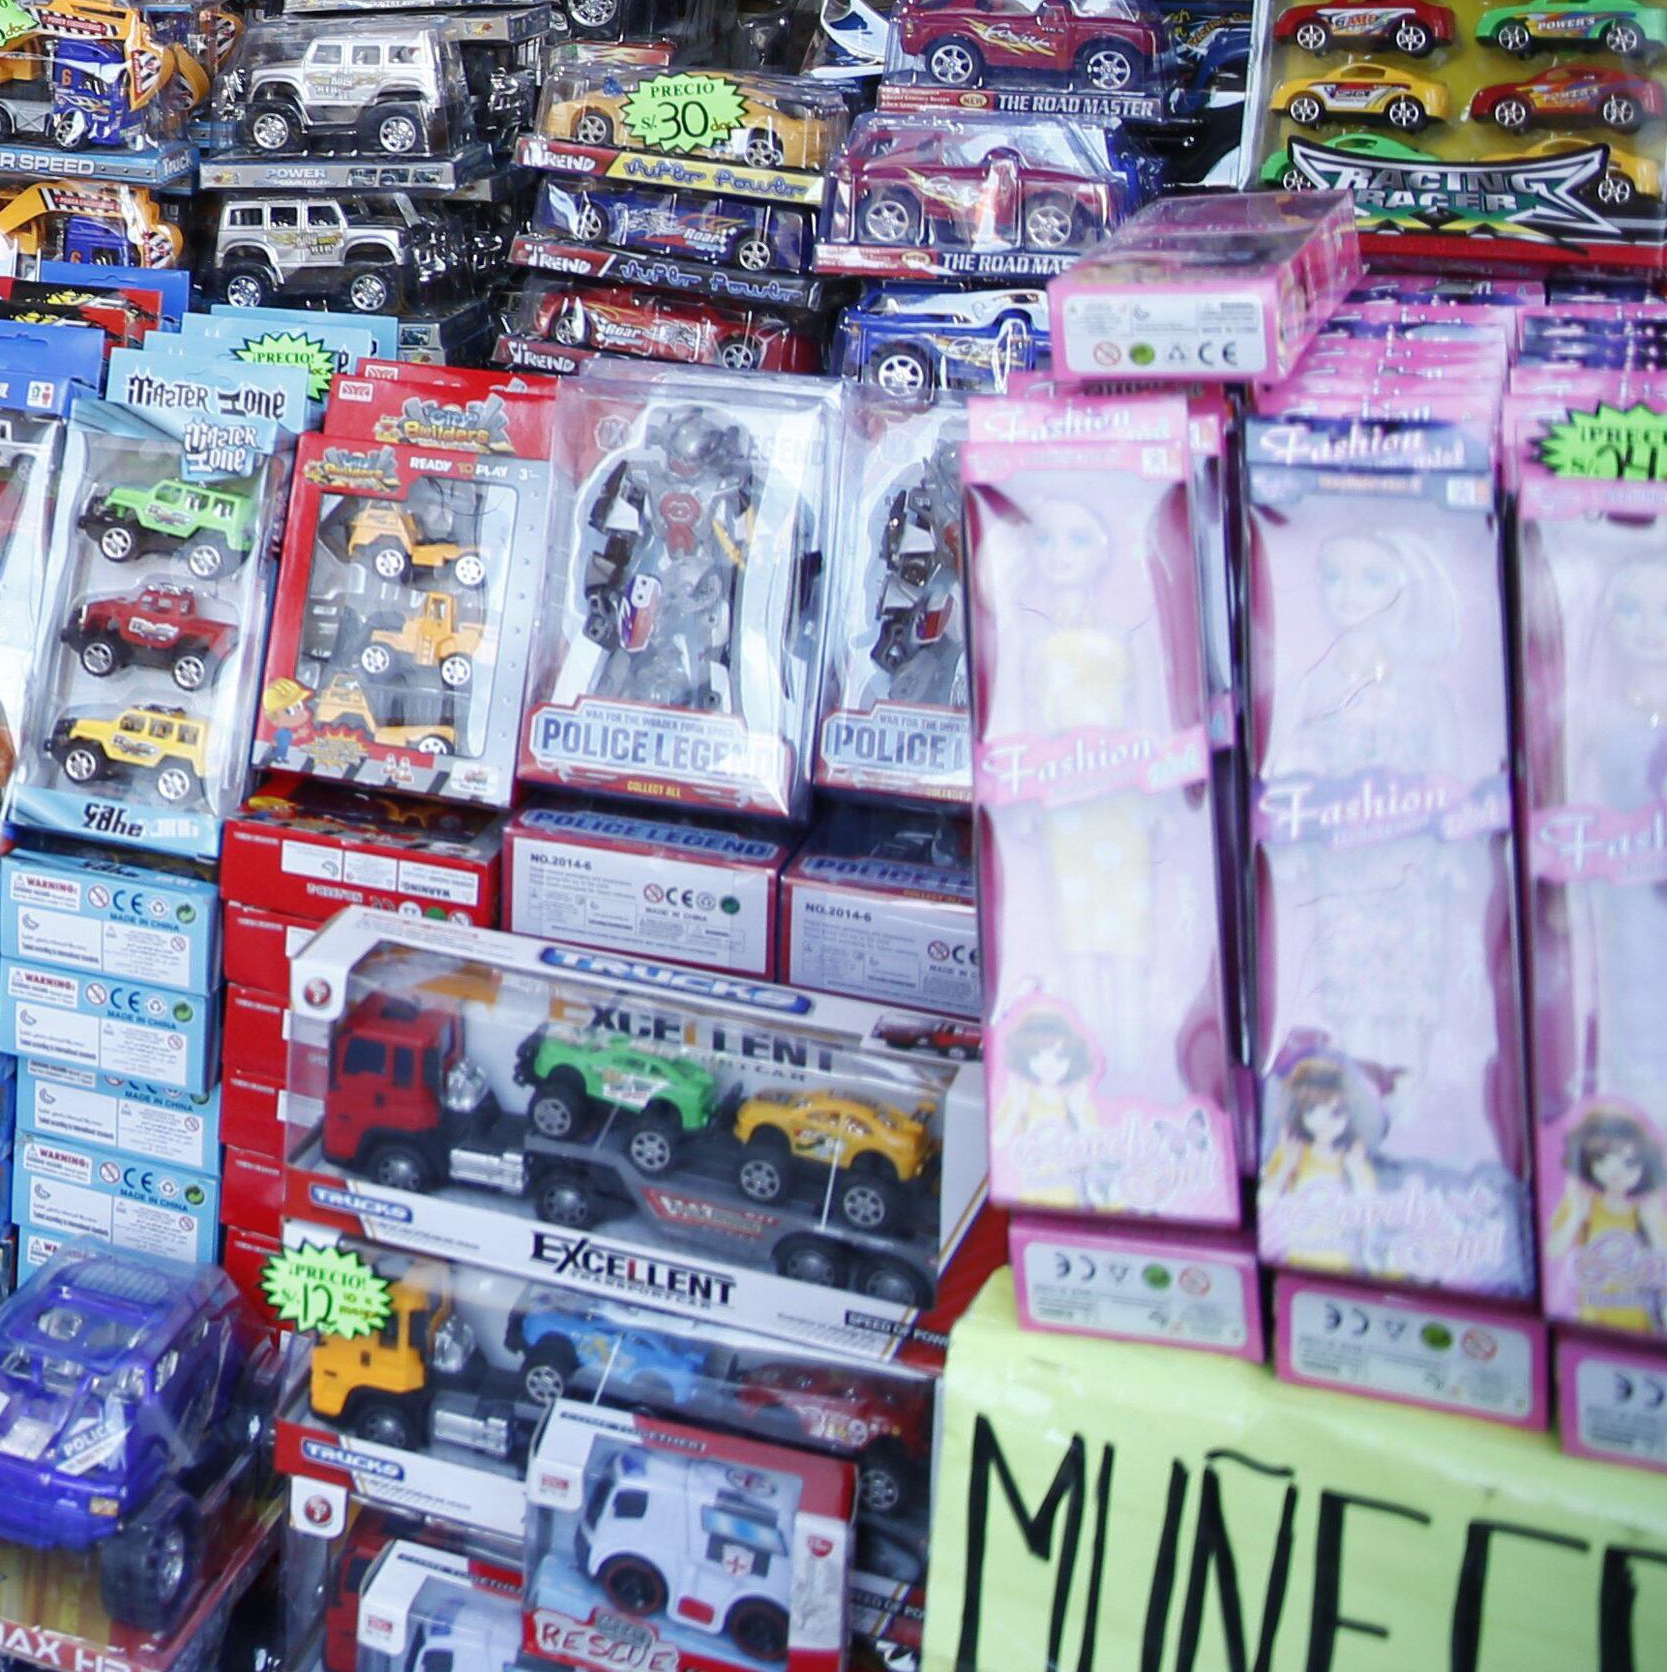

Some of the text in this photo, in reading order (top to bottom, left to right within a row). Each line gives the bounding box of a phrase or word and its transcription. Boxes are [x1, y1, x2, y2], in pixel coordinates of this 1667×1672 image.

[649, 80, 716, 100] PRECIO
[997, 95, 1154, 118] THE ROAD MASTER
[17, 153, 95, 175] SPEED
[1355, 190, 1518, 212] RACER
[252, 352, 314, 364] ¡PRECIO!
[542, 718, 649, 764] POLICE
[836, 725, 946, 766] POLICE
[530, 854, 591, 871] NO.2014-6
[110, 913, 134, 923] MADE
[149, 918, 179, 932] CHINA
[312, 1185, 412, 1222] TRUCKS
[287, 1264, 370, 1291] ¡PRECIO!
[530, 1229, 737, 1309] EXCELLENT
[303, 1438, 403, 1478] TRUCKS
